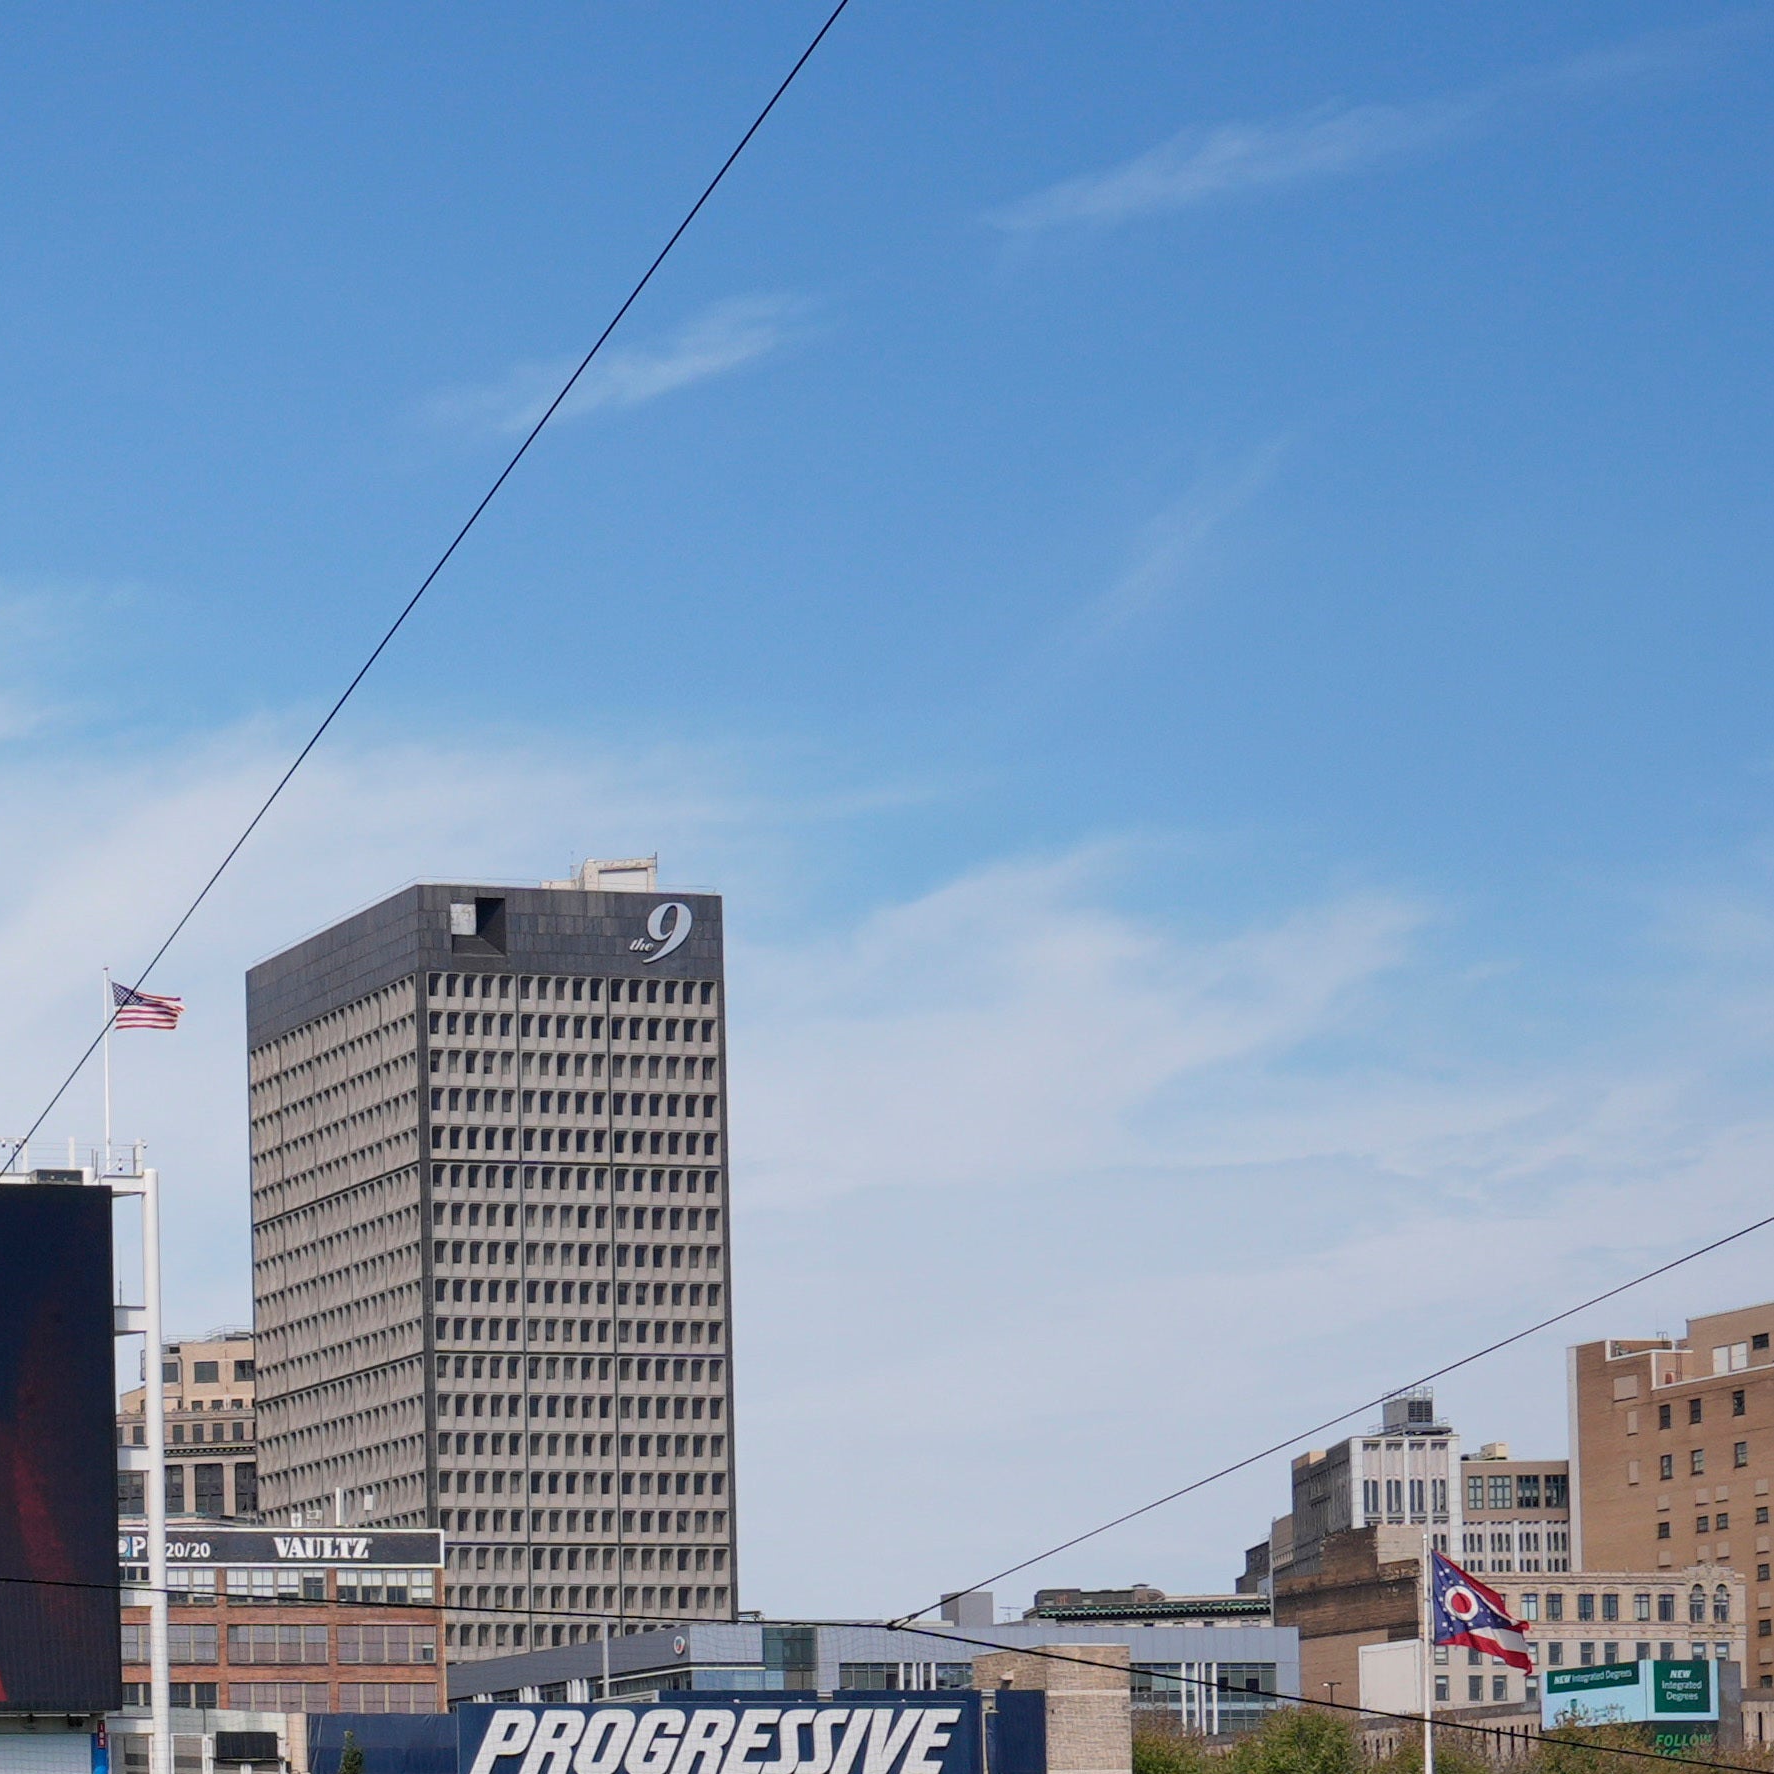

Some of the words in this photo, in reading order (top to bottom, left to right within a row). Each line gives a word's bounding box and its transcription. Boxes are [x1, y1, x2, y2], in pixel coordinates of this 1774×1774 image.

[641, 902, 693, 964] 9
[629, 936, 654, 954] the
[273, 1536, 370, 1560] VAULTZ
[1669, 1669, 1692, 1679] NEW
[1661, 1679, 1702, 1692] Integrated
[1665, 1690, 1699, 1702] Degrees
